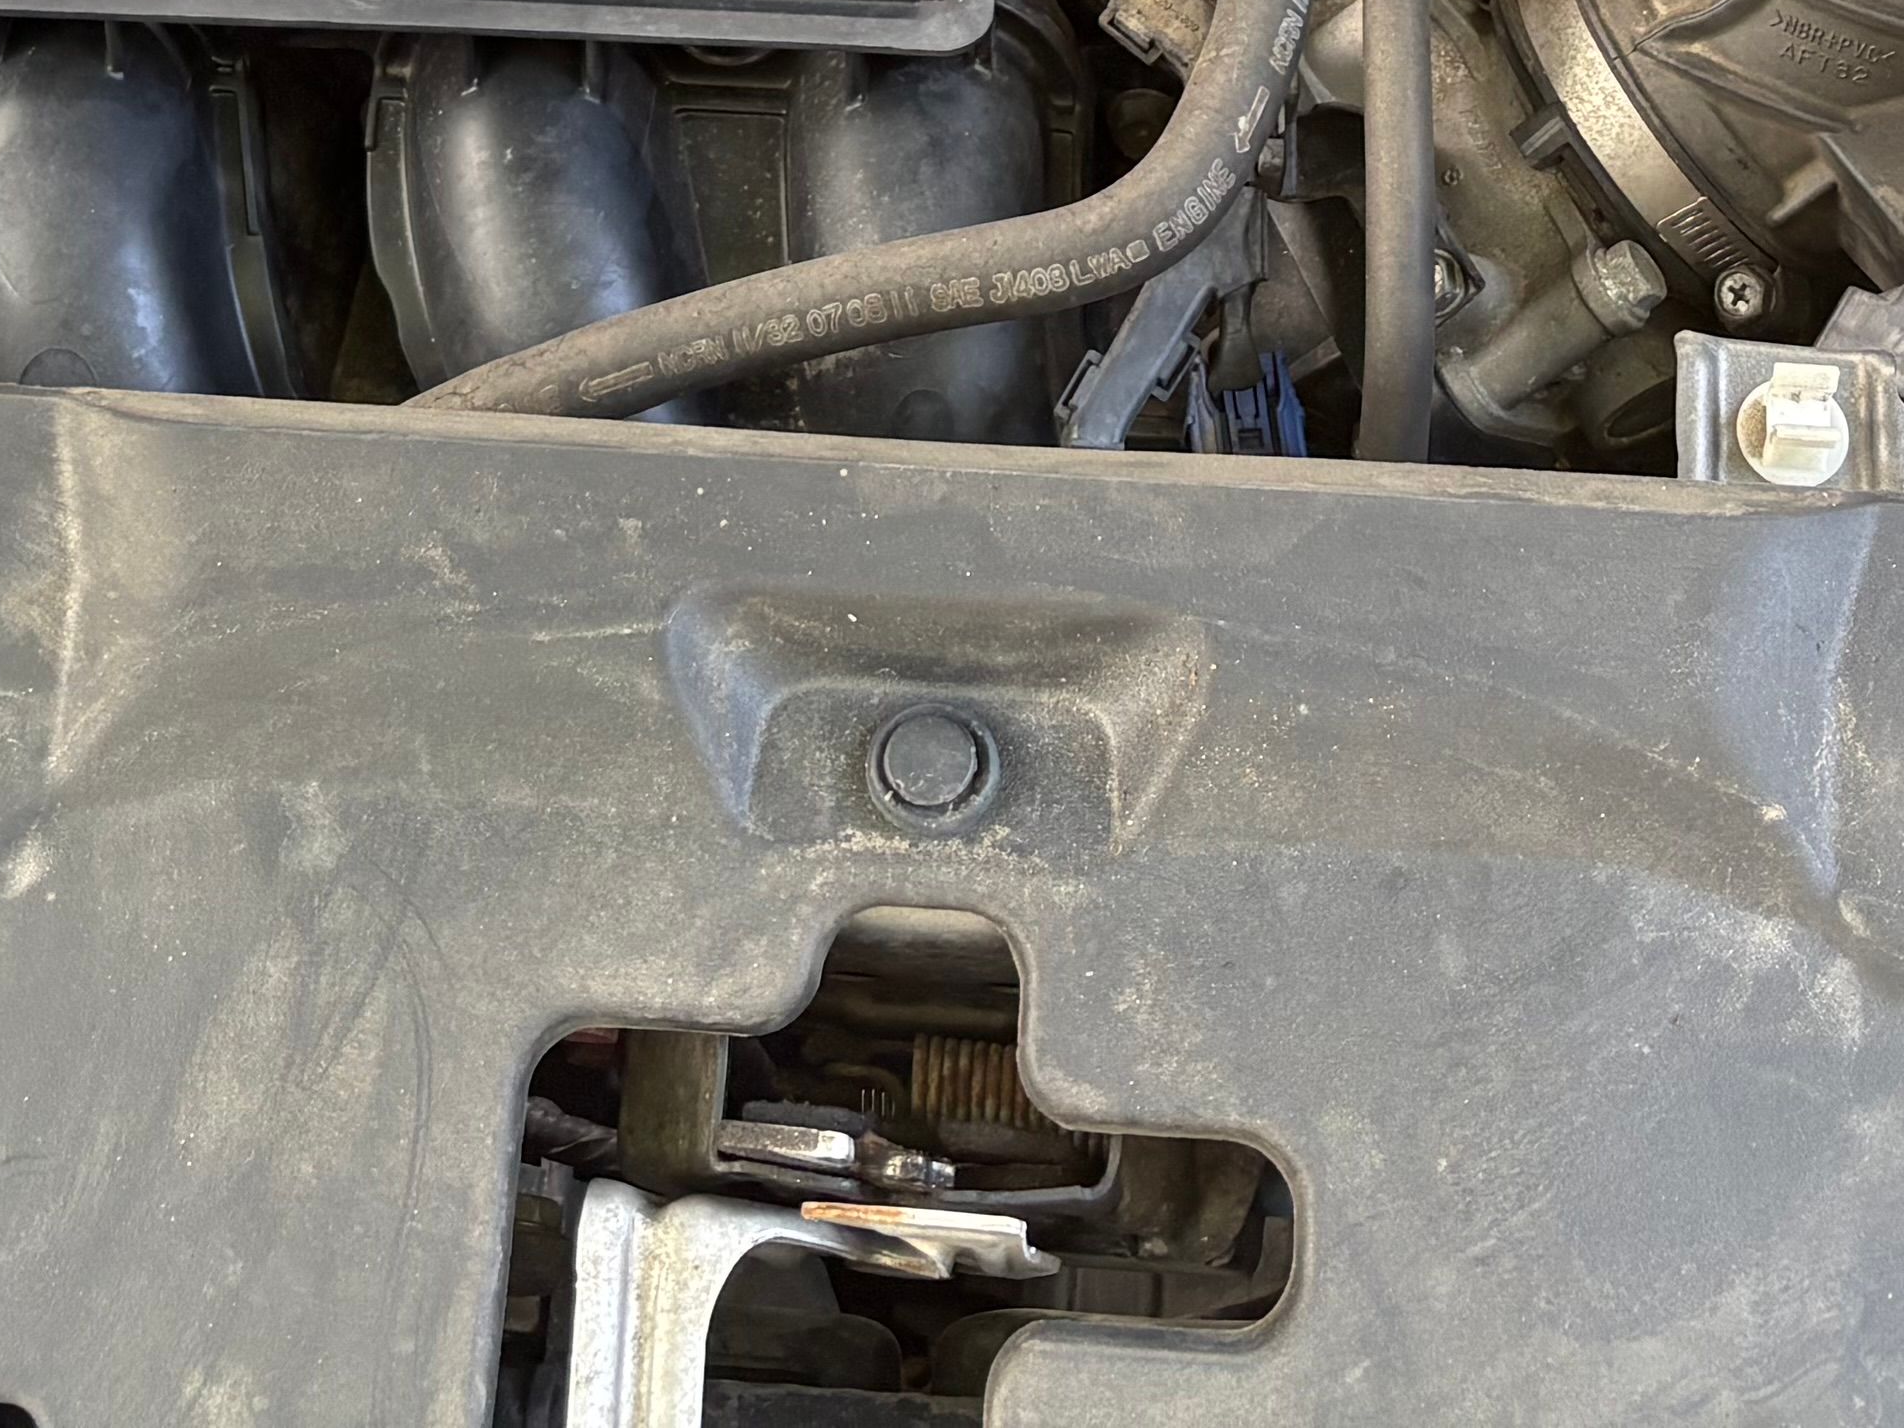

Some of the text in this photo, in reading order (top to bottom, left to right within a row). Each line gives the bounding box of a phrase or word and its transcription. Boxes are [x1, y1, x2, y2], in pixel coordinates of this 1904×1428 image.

[805, 301, 844, 337] 07
[929, 276, 984, 313] SAE
[1152, 157, 1238, 253] ENGINE
